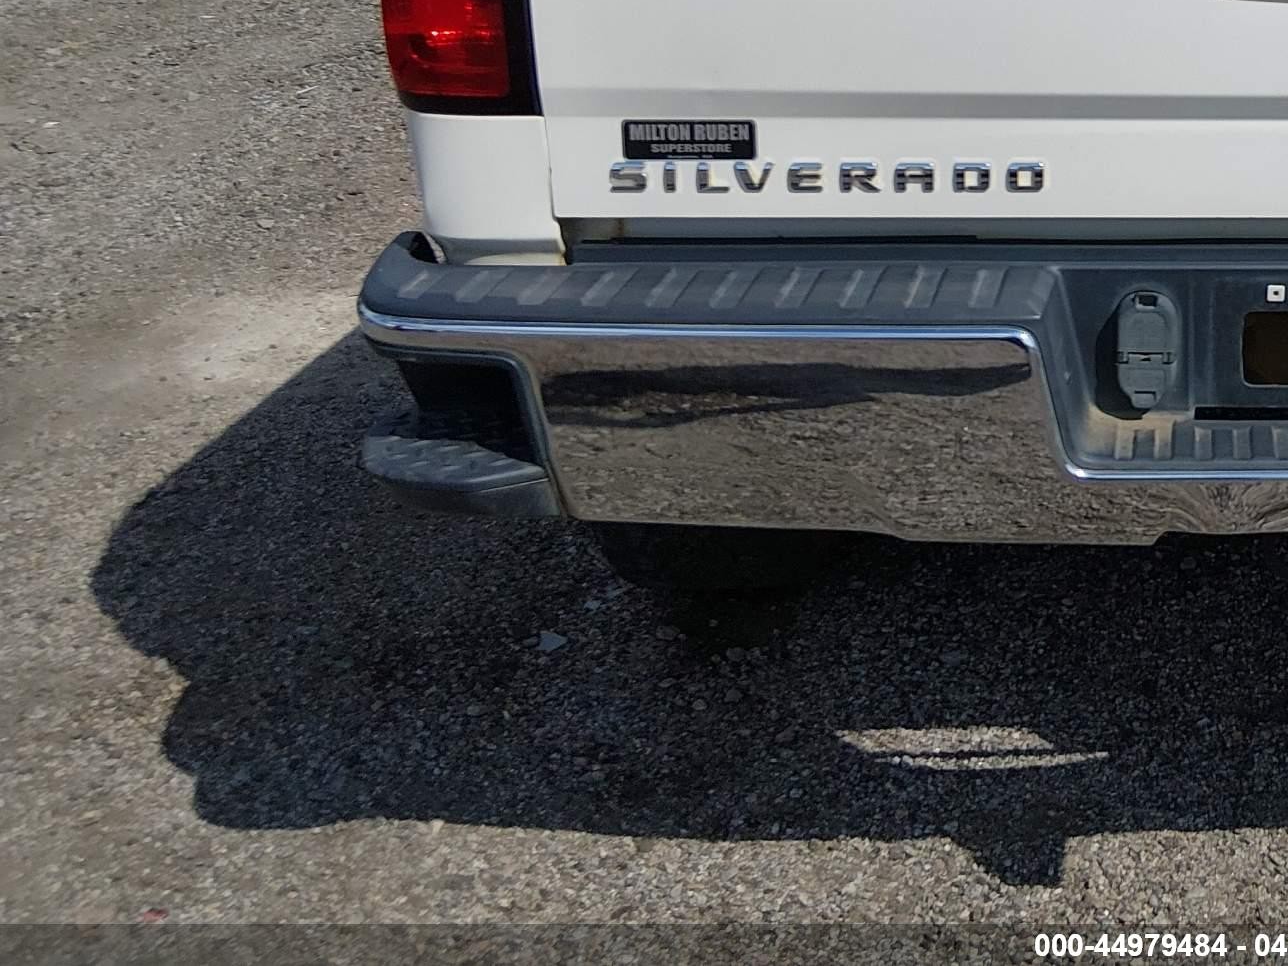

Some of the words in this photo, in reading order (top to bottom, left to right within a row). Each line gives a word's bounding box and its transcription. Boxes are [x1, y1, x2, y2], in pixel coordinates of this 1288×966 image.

[628, 123, 692, 141] MILTON
[693, 123, 750, 141] RUBEN
[650, 143, 733, 153] SUPERSTORE
[609, 161, 1046, 194] SILVERADO
